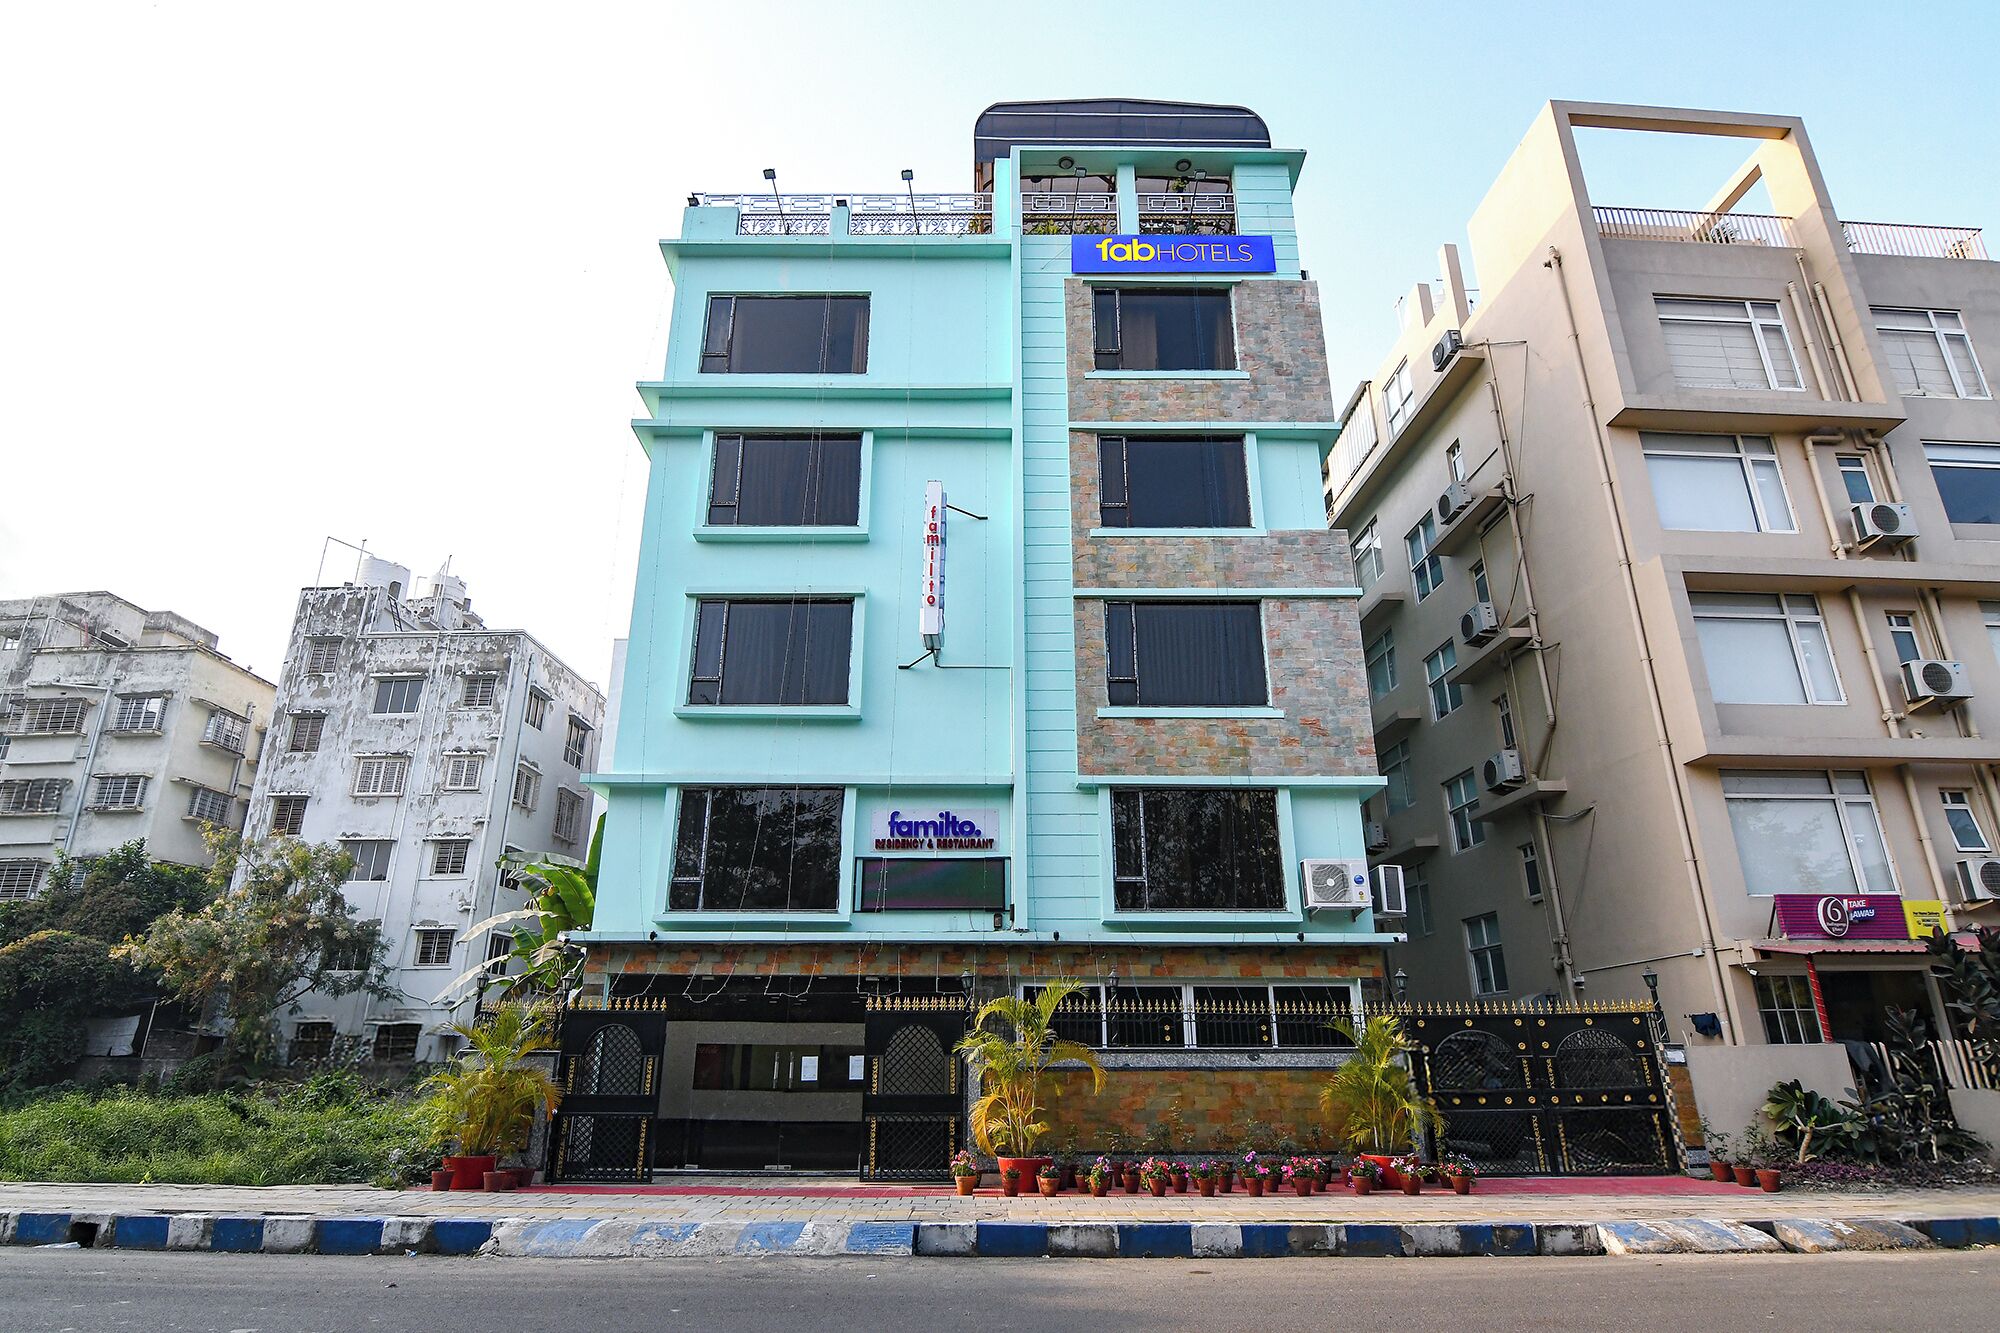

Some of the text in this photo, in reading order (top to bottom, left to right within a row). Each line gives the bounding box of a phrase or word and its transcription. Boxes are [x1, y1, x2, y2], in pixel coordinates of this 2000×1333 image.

[927, 506, 939, 606] familto
[875, 839, 994, 849] RESIDENCY & RESTAURANT
[1827, 900, 1841, 921] 6
[1852, 909, 1875, 918] AWAY
